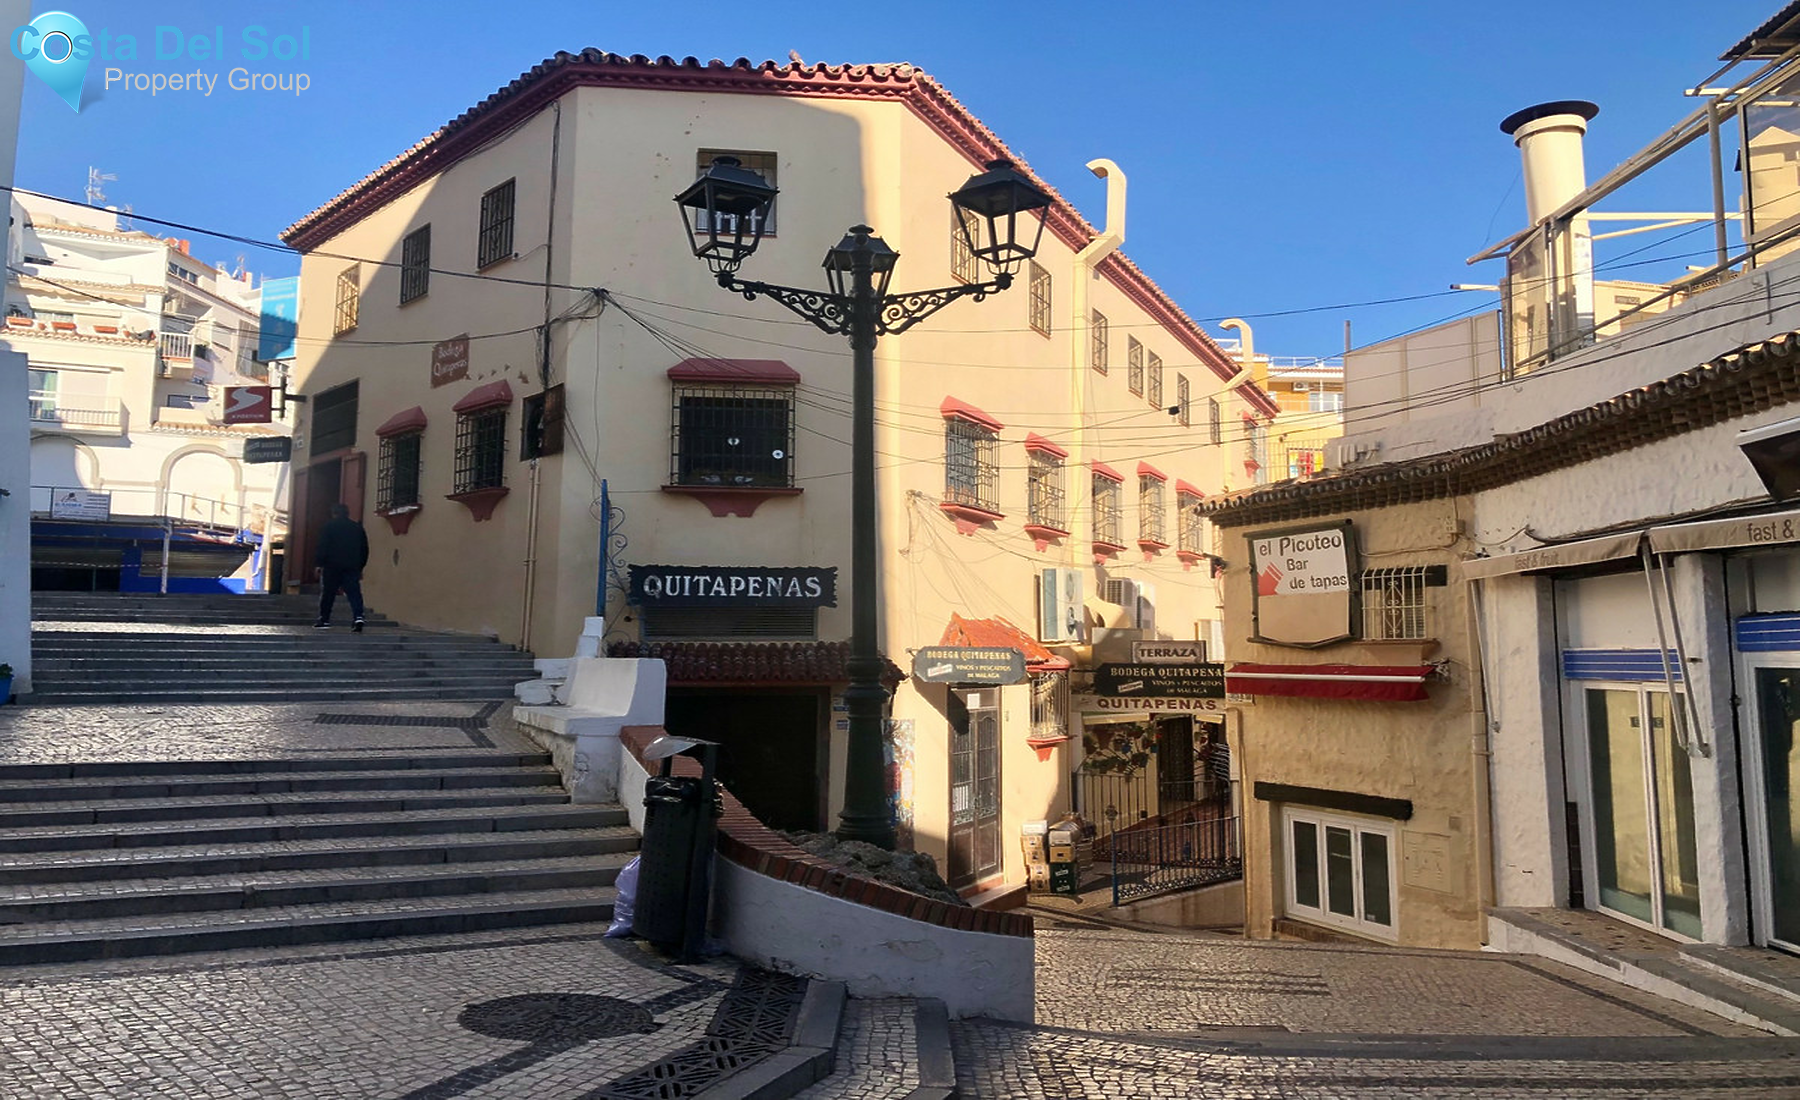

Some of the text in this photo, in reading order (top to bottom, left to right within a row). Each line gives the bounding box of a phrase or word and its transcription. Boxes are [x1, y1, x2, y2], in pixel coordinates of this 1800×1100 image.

[1747, 519, 1795, 542] fast &
[1260, 535, 1342, 556] el Picoteo
[1286, 558, 1309, 571] Bar
[643, 575, 822, 599] QUITAPENAS
[1290, 575, 1348, 590] de tapas
[926, 650, 1012, 661] BODEGA QUITAPENAS
[1139, 648, 1197, 658] TERRAZA
[1110, 667, 1224, 679] BODEGA QUITAPENA
[1097, 698, 1217, 711] QUITAPENAS
